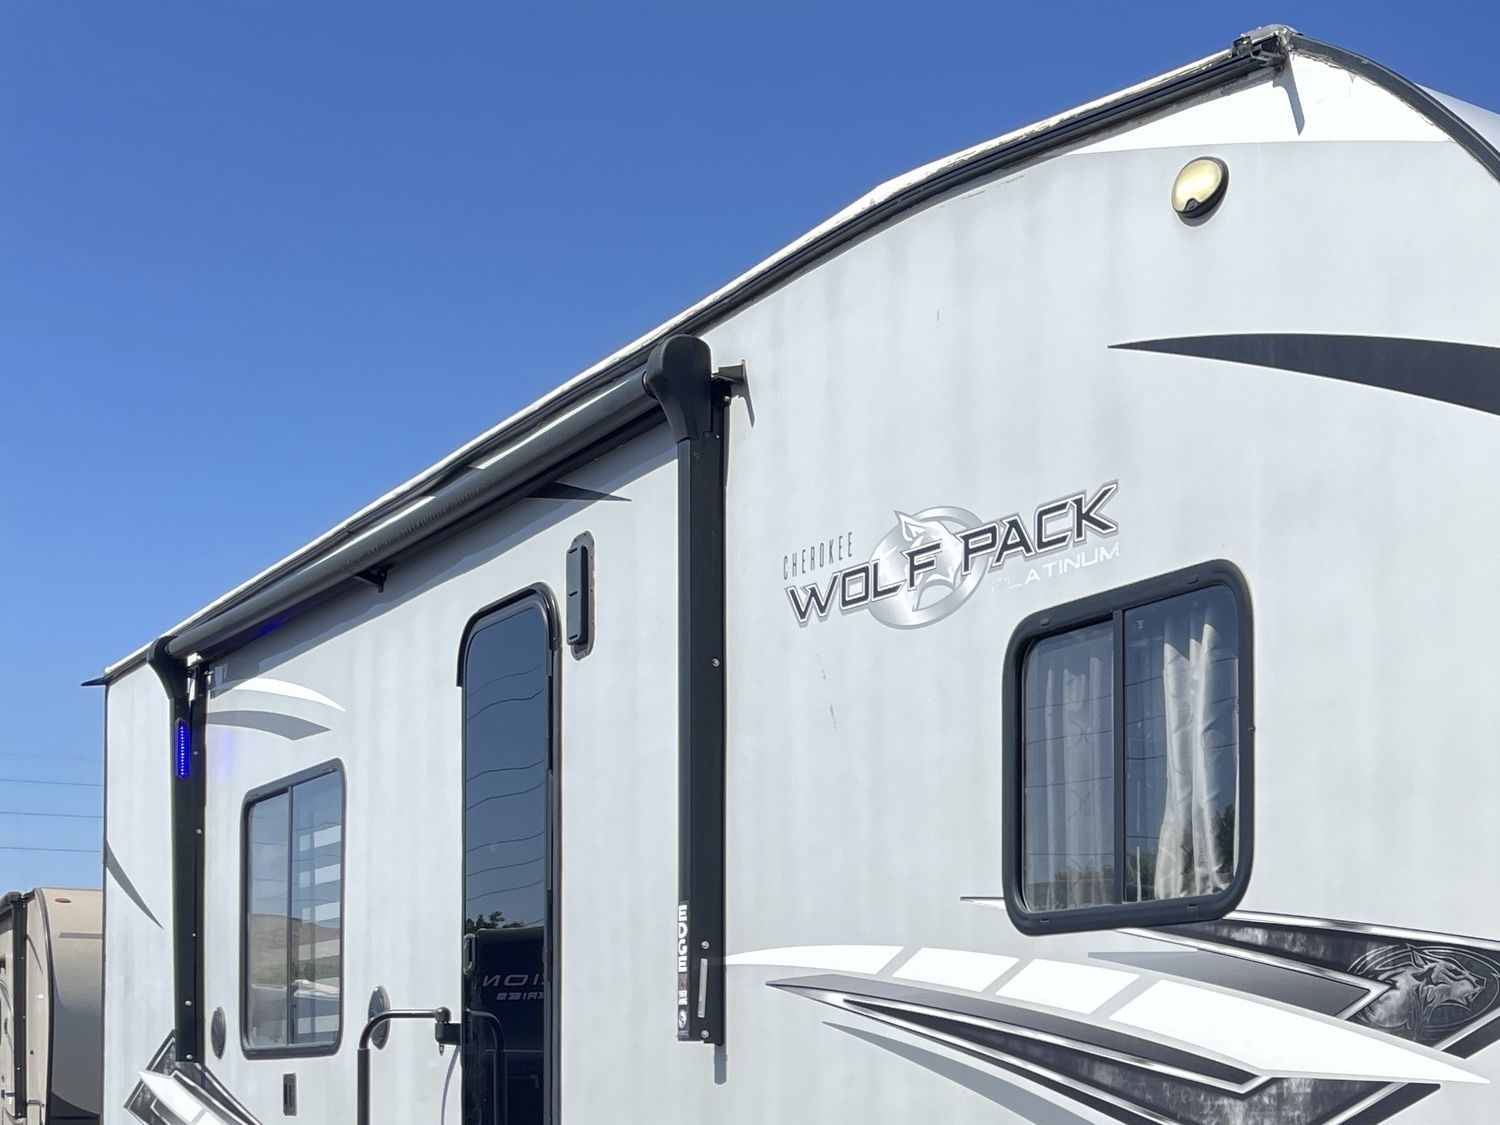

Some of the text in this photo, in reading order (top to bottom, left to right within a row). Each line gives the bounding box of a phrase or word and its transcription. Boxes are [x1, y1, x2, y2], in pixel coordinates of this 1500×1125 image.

[783, 531, 854, 581] CHEROKEE
[785, 479, 1119, 628] WOLF PACK
